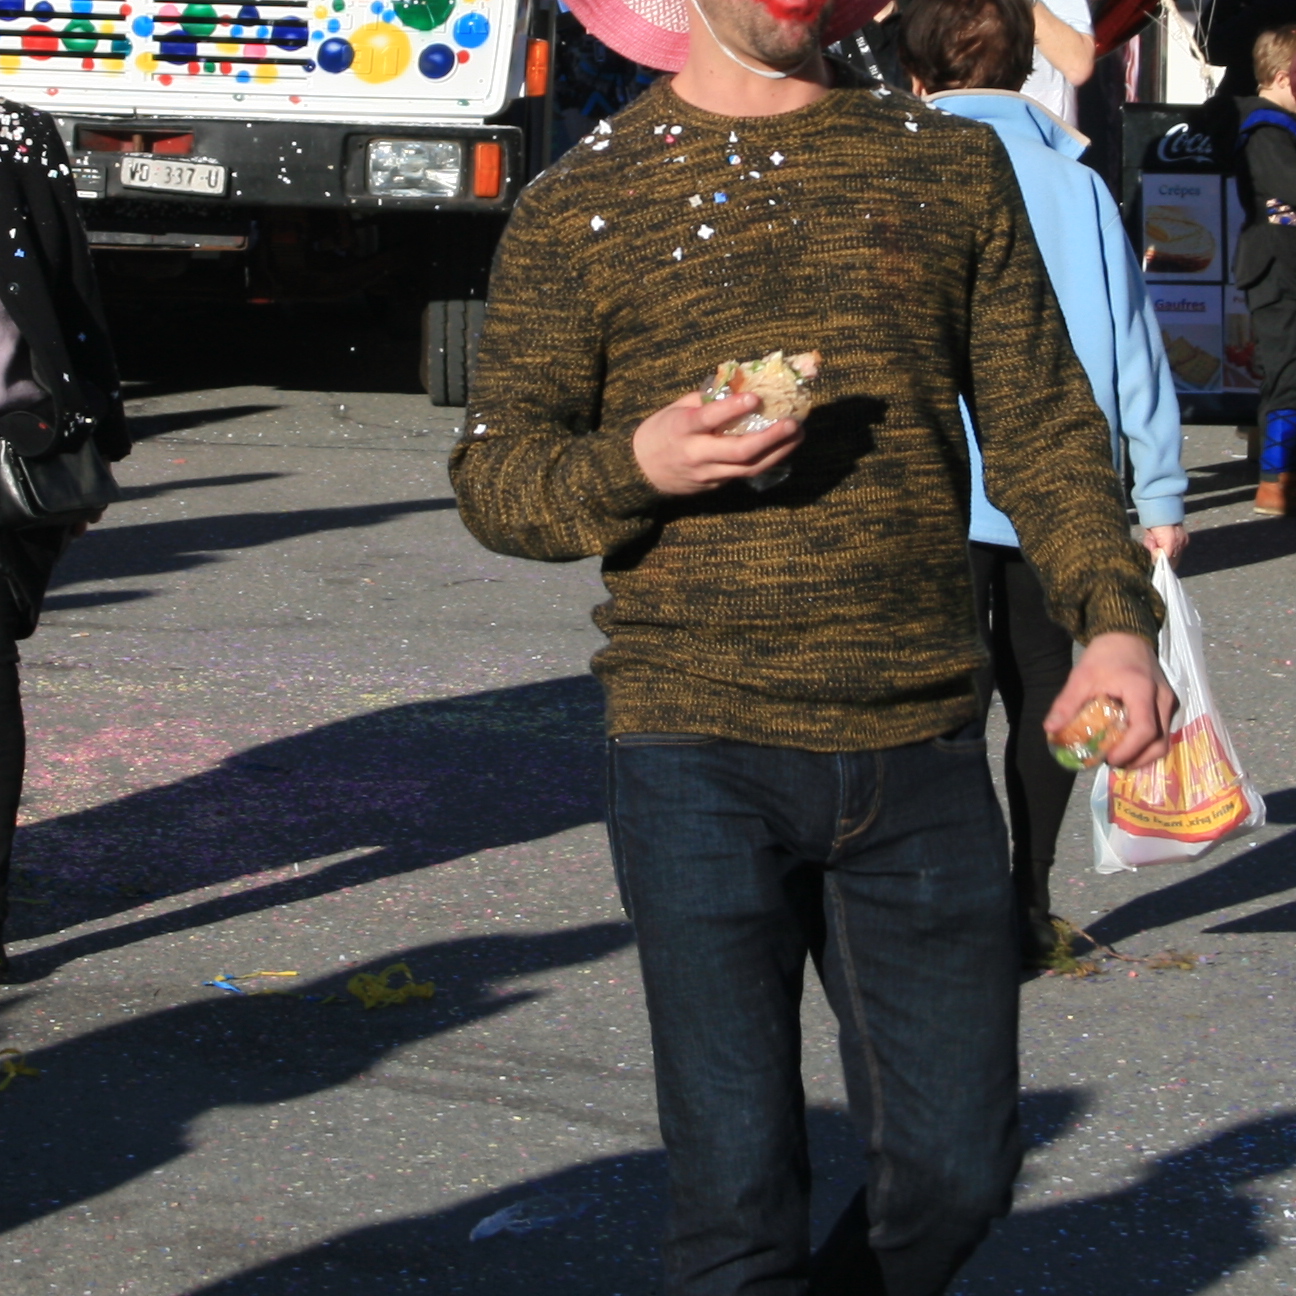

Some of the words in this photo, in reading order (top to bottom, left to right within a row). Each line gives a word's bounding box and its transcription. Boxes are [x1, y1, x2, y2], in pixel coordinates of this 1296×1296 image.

[164, 166, 195, 186] 337
[1158, 184, 1202, 199] Crêpes
[1154, 298, 1207, 313] Gaufres
